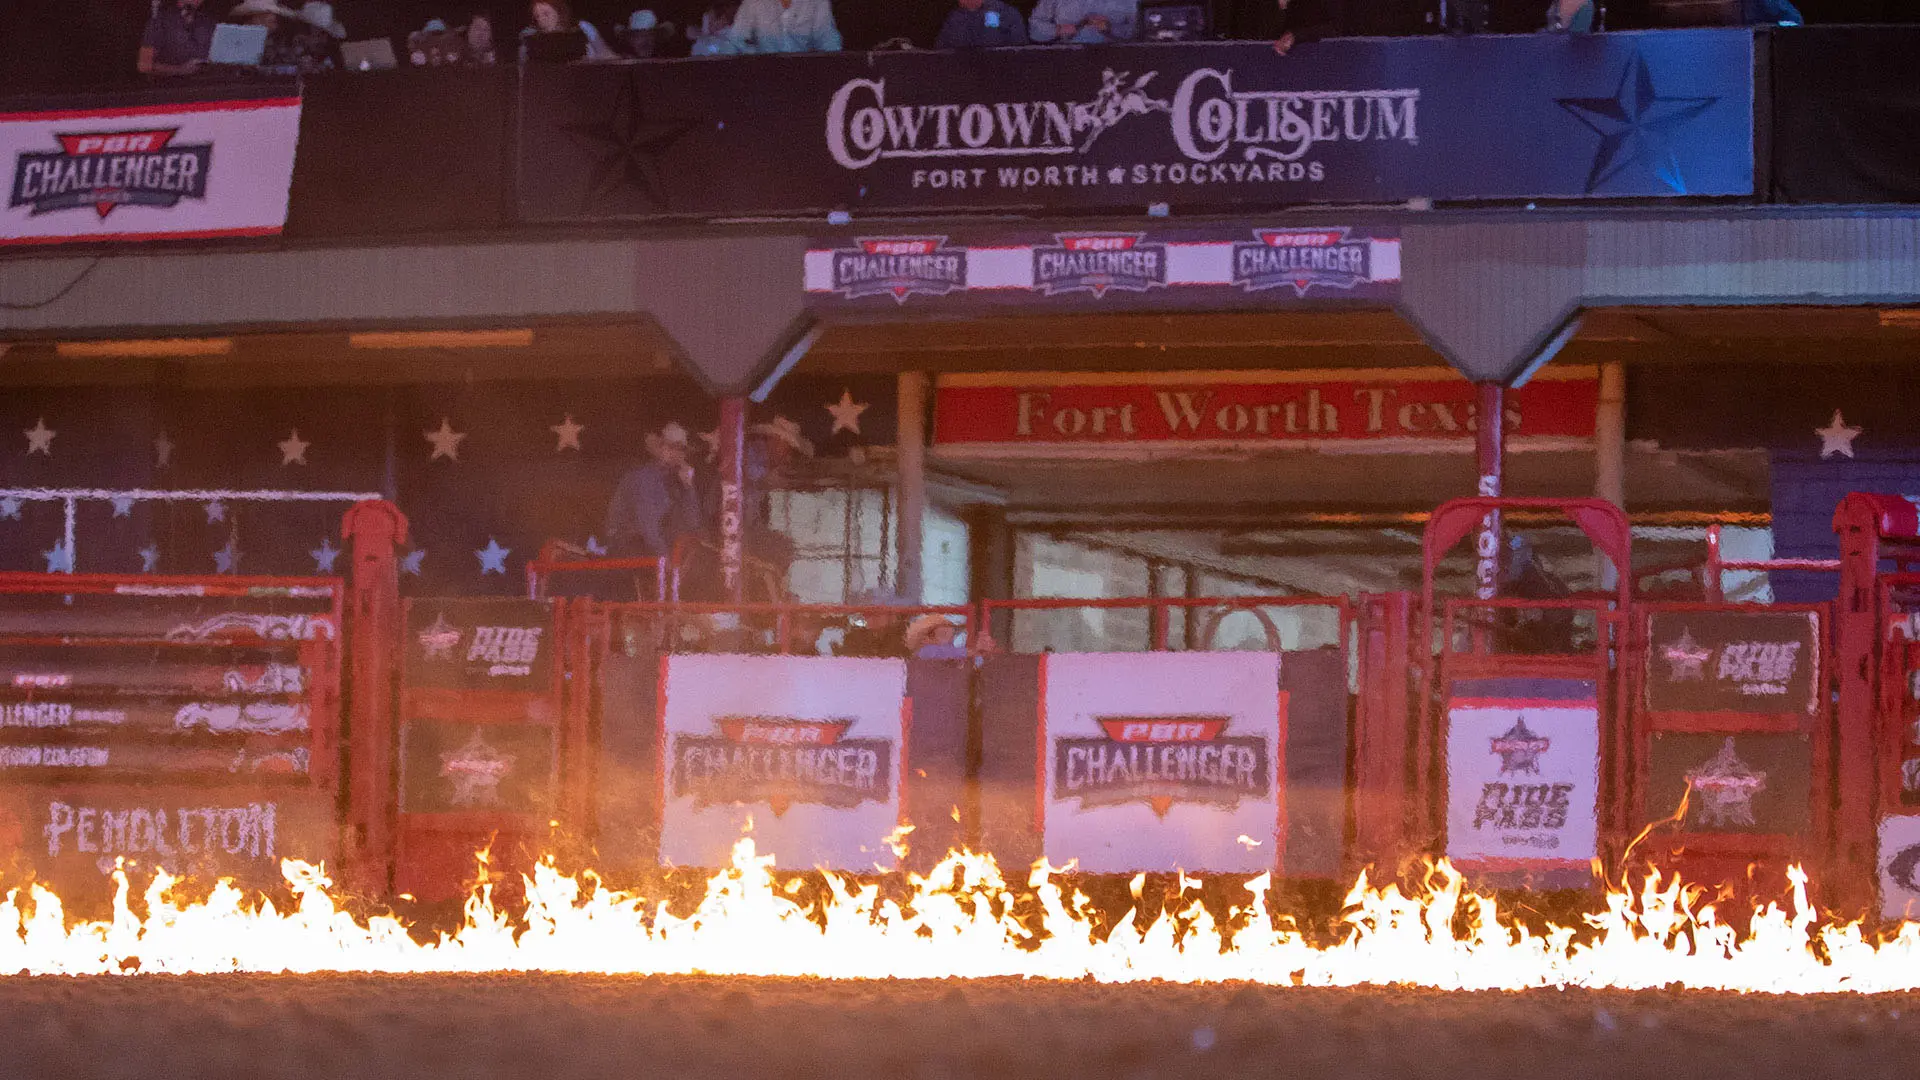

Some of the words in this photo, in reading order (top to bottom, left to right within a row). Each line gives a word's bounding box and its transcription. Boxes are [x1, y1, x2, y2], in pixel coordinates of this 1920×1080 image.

[825, 78, 1075, 170] COWTOWN
[1171, 67, 1420, 162] COLISEUM
[21, 153, 199, 198] CHALLENGER
[912, 168, 987, 189] FORT
[998, 166, 1099, 187] WORTH
[1131, 161, 1326, 185] STOCKYARDS
[839, 254, 959, 285] CHALLENGER
[1039, 250, 1158, 281] CHALLENGER
[1238, 246, 1364, 277] CHALLENGER
[1016, 392, 1138, 436] Fort
[1155, 387, 1340, 434] Worth
[1066, 744, 1257, 790] CHALLENGER
